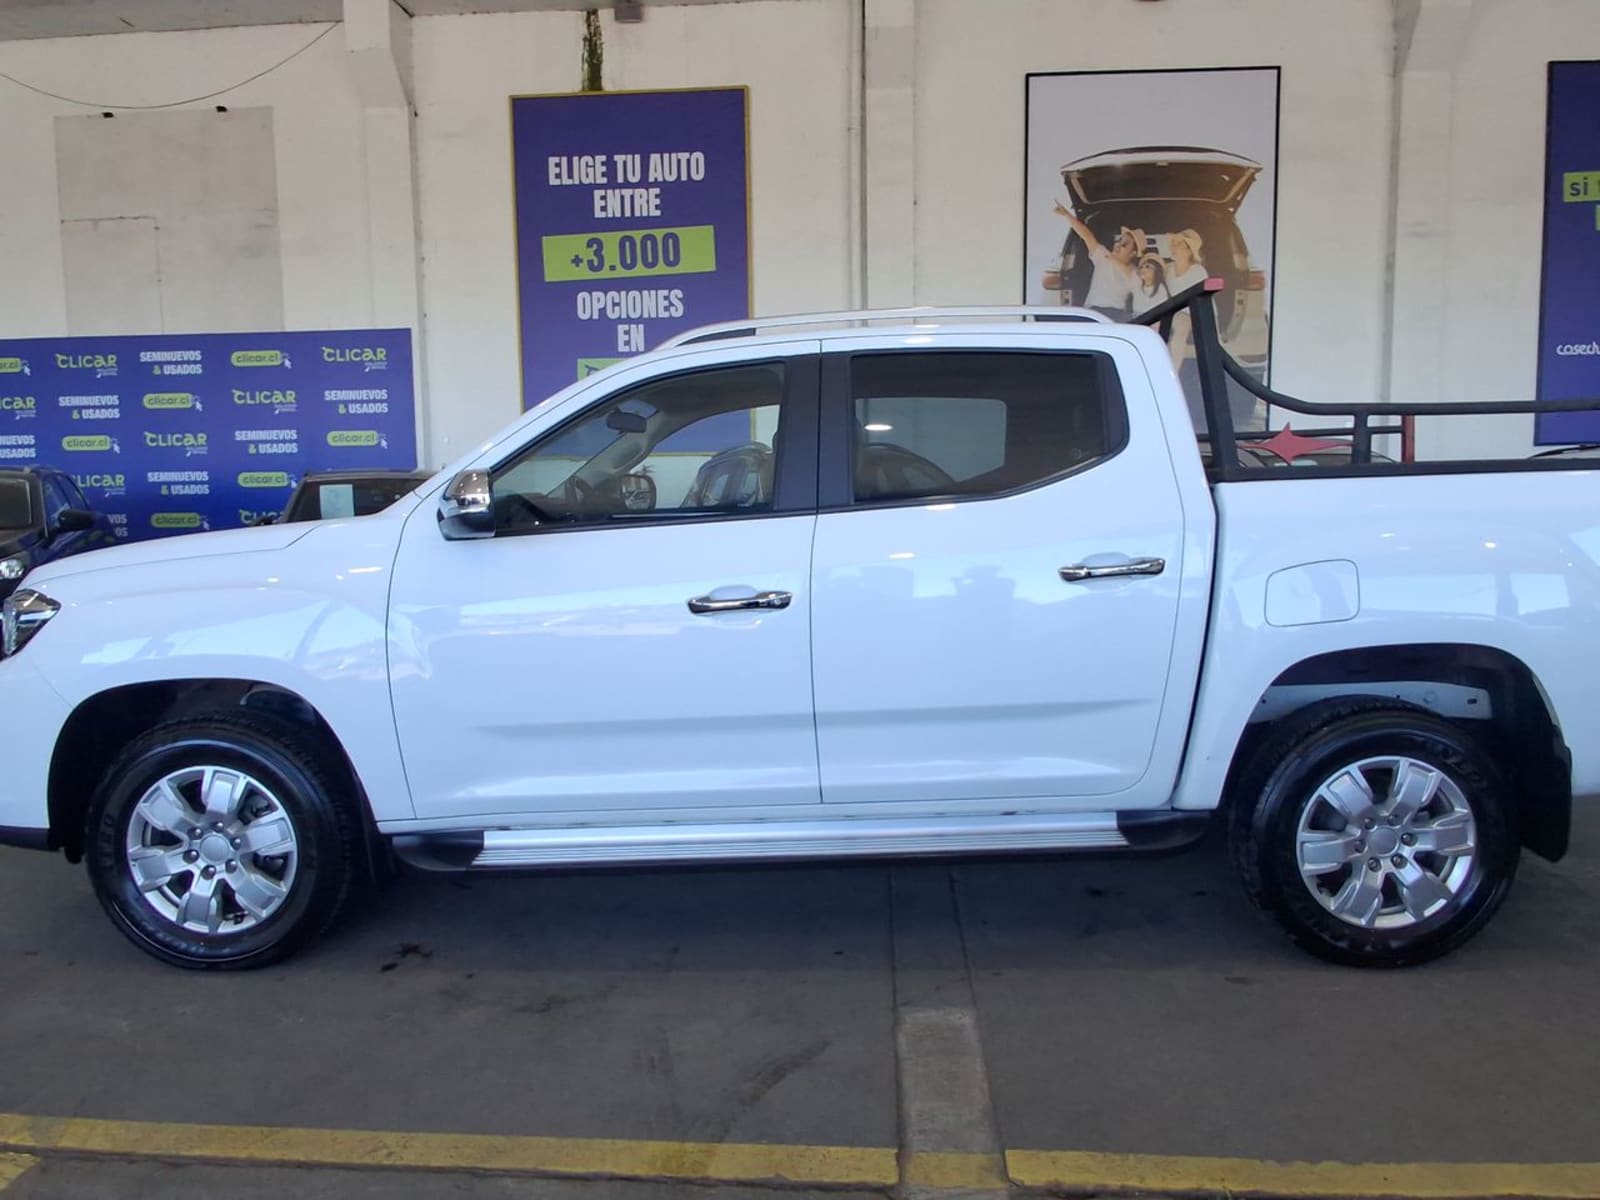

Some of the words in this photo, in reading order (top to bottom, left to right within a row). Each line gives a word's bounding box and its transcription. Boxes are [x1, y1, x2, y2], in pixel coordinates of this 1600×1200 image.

[548, 155, 608, 186] ELIGE
[614, 154, 641, 184] TU
[648, 152, 704, 182] AUTO
[1570, 177, 1588, 196] si
[593, 188, 661, 218] ENTRE
[570, 232, 681, 272] +3.000
[576, 290, 684, 320] OPCIONES
[617, 324, 645, 352] EN
[140, 351, 201, 362] SEMINUEVOS
[153, 365, 161, 375] &
[163, 364, 202, 375] USADOS
[325, 389, 388, 400] SEMINUEVOS
[59, 395, 119, 406] SEMINUEVOS
[72, 409, 80, 419] &
[82, 409, 120, 419] USADOS
[338, 404, 346, 414] &
[348, 403, 388, 413] USADOS
[235, 430, 297, 440] SEMINUEVOS
[0, 448, 36, 458] USADOS
[248, 444, 256, 454] &
[259, 443, 298, 453] USADOS
[147, 471, 208, 482] SEMINUEVOS
[161, 485, 168, 495] &
[171, 484, 209, 494] USADOS
